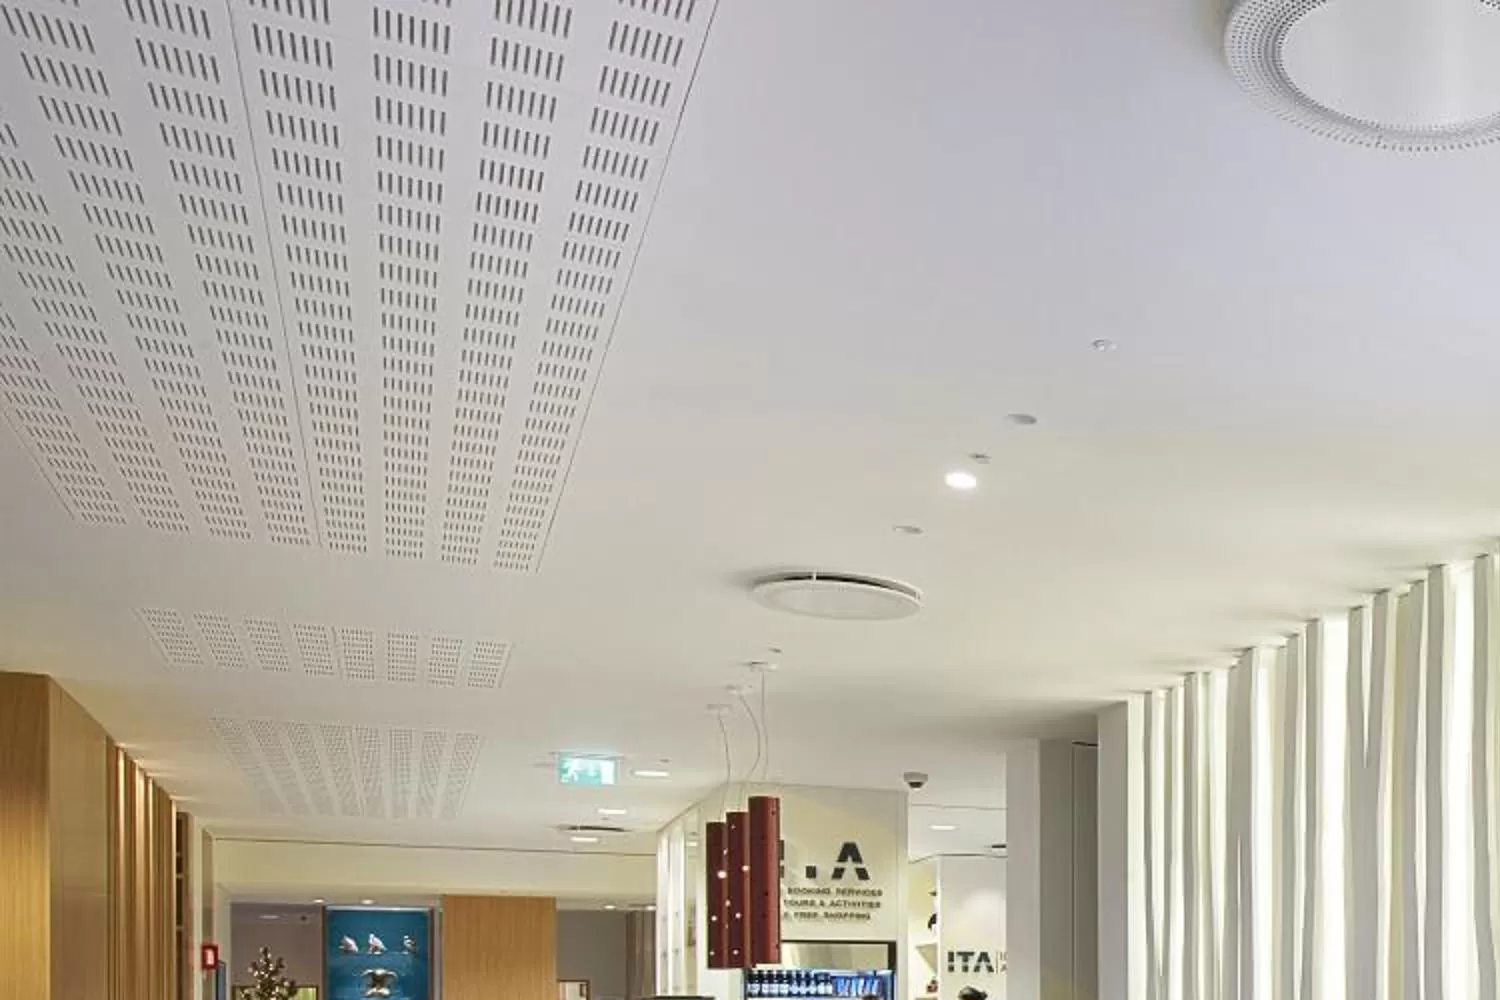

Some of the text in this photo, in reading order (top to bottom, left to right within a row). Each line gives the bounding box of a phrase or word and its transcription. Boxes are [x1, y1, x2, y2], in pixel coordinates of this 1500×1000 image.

[836, 887, 883, 897] SERVICES
[829, 899, 882, 909] ACTIVITIES
[947, 951, 995, 973] ITA
